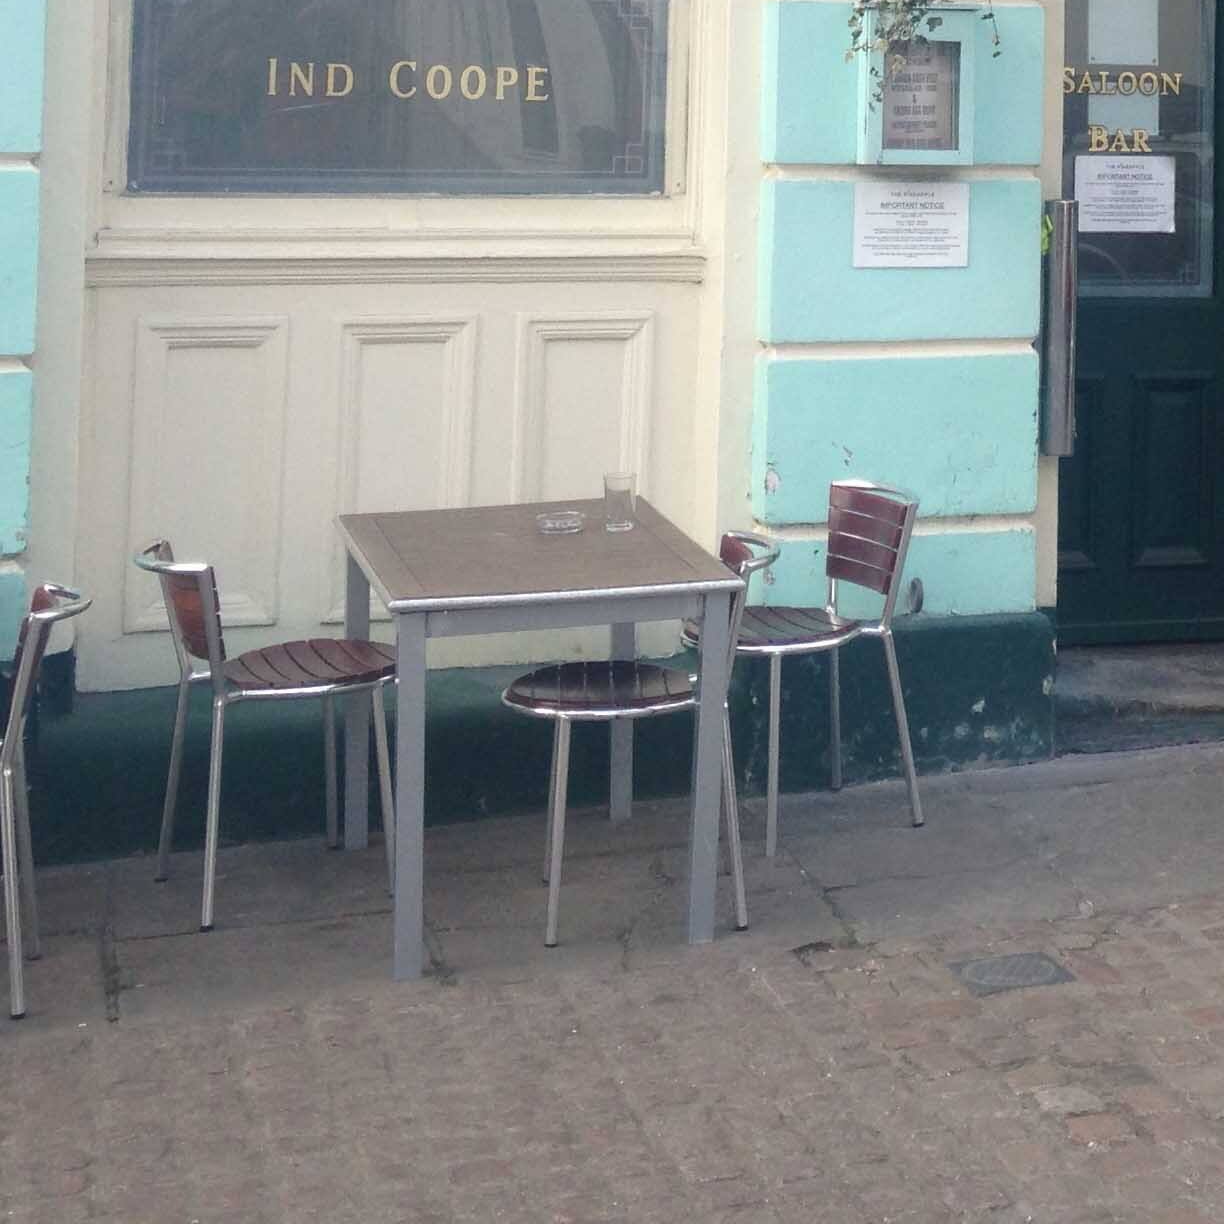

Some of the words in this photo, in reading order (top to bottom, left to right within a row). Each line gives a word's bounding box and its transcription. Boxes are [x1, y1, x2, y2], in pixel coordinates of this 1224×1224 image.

[266, 57, 354, 97] IND
[389, 60, 549, 101] COOPE
[1063, 66, 1182, 97] SALOON
[1087, 123, 1152, 154] BAR
